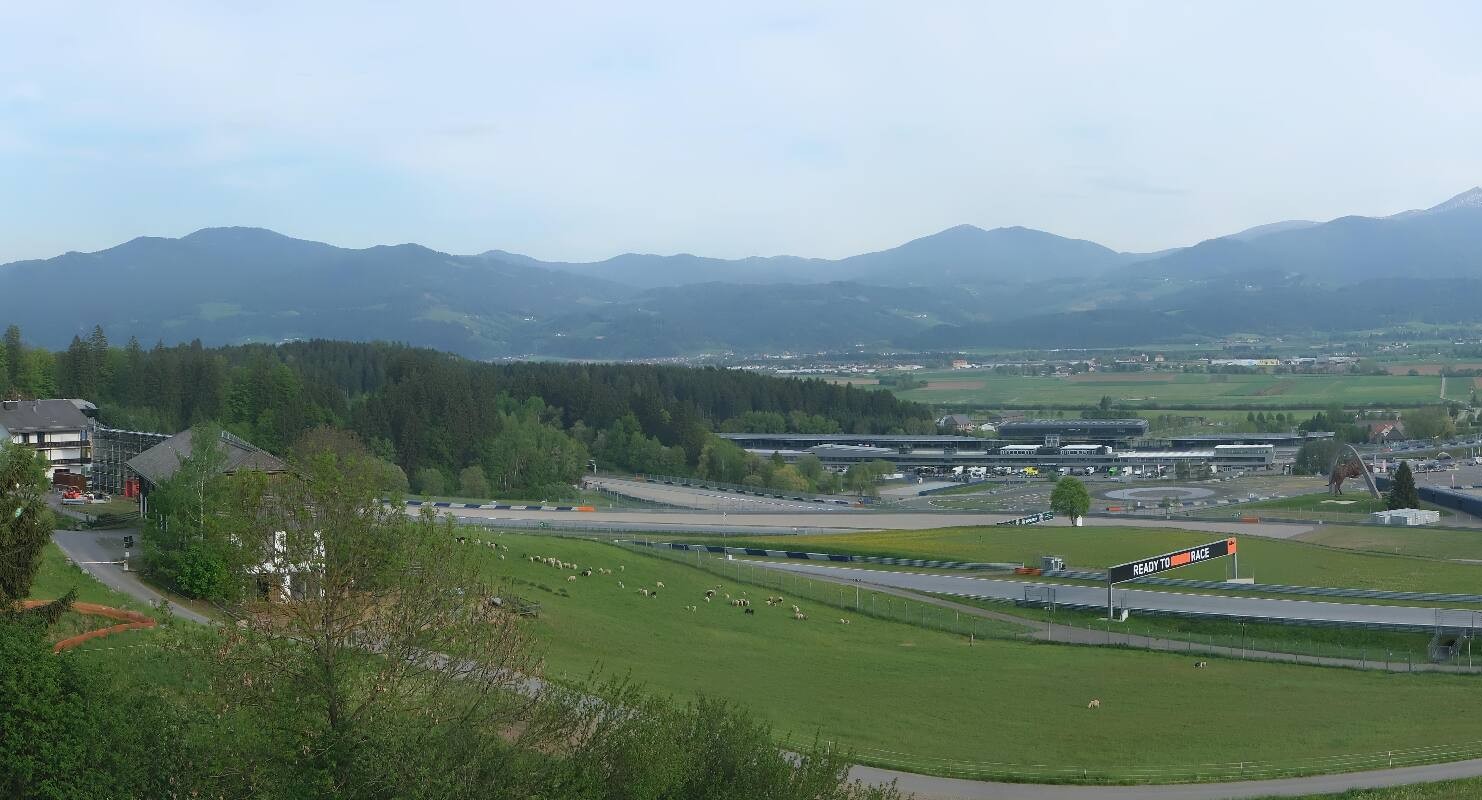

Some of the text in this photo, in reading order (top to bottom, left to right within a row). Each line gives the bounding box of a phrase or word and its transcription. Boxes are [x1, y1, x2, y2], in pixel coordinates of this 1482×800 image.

[1133, 547, 1210, 576] READY TO RACE
